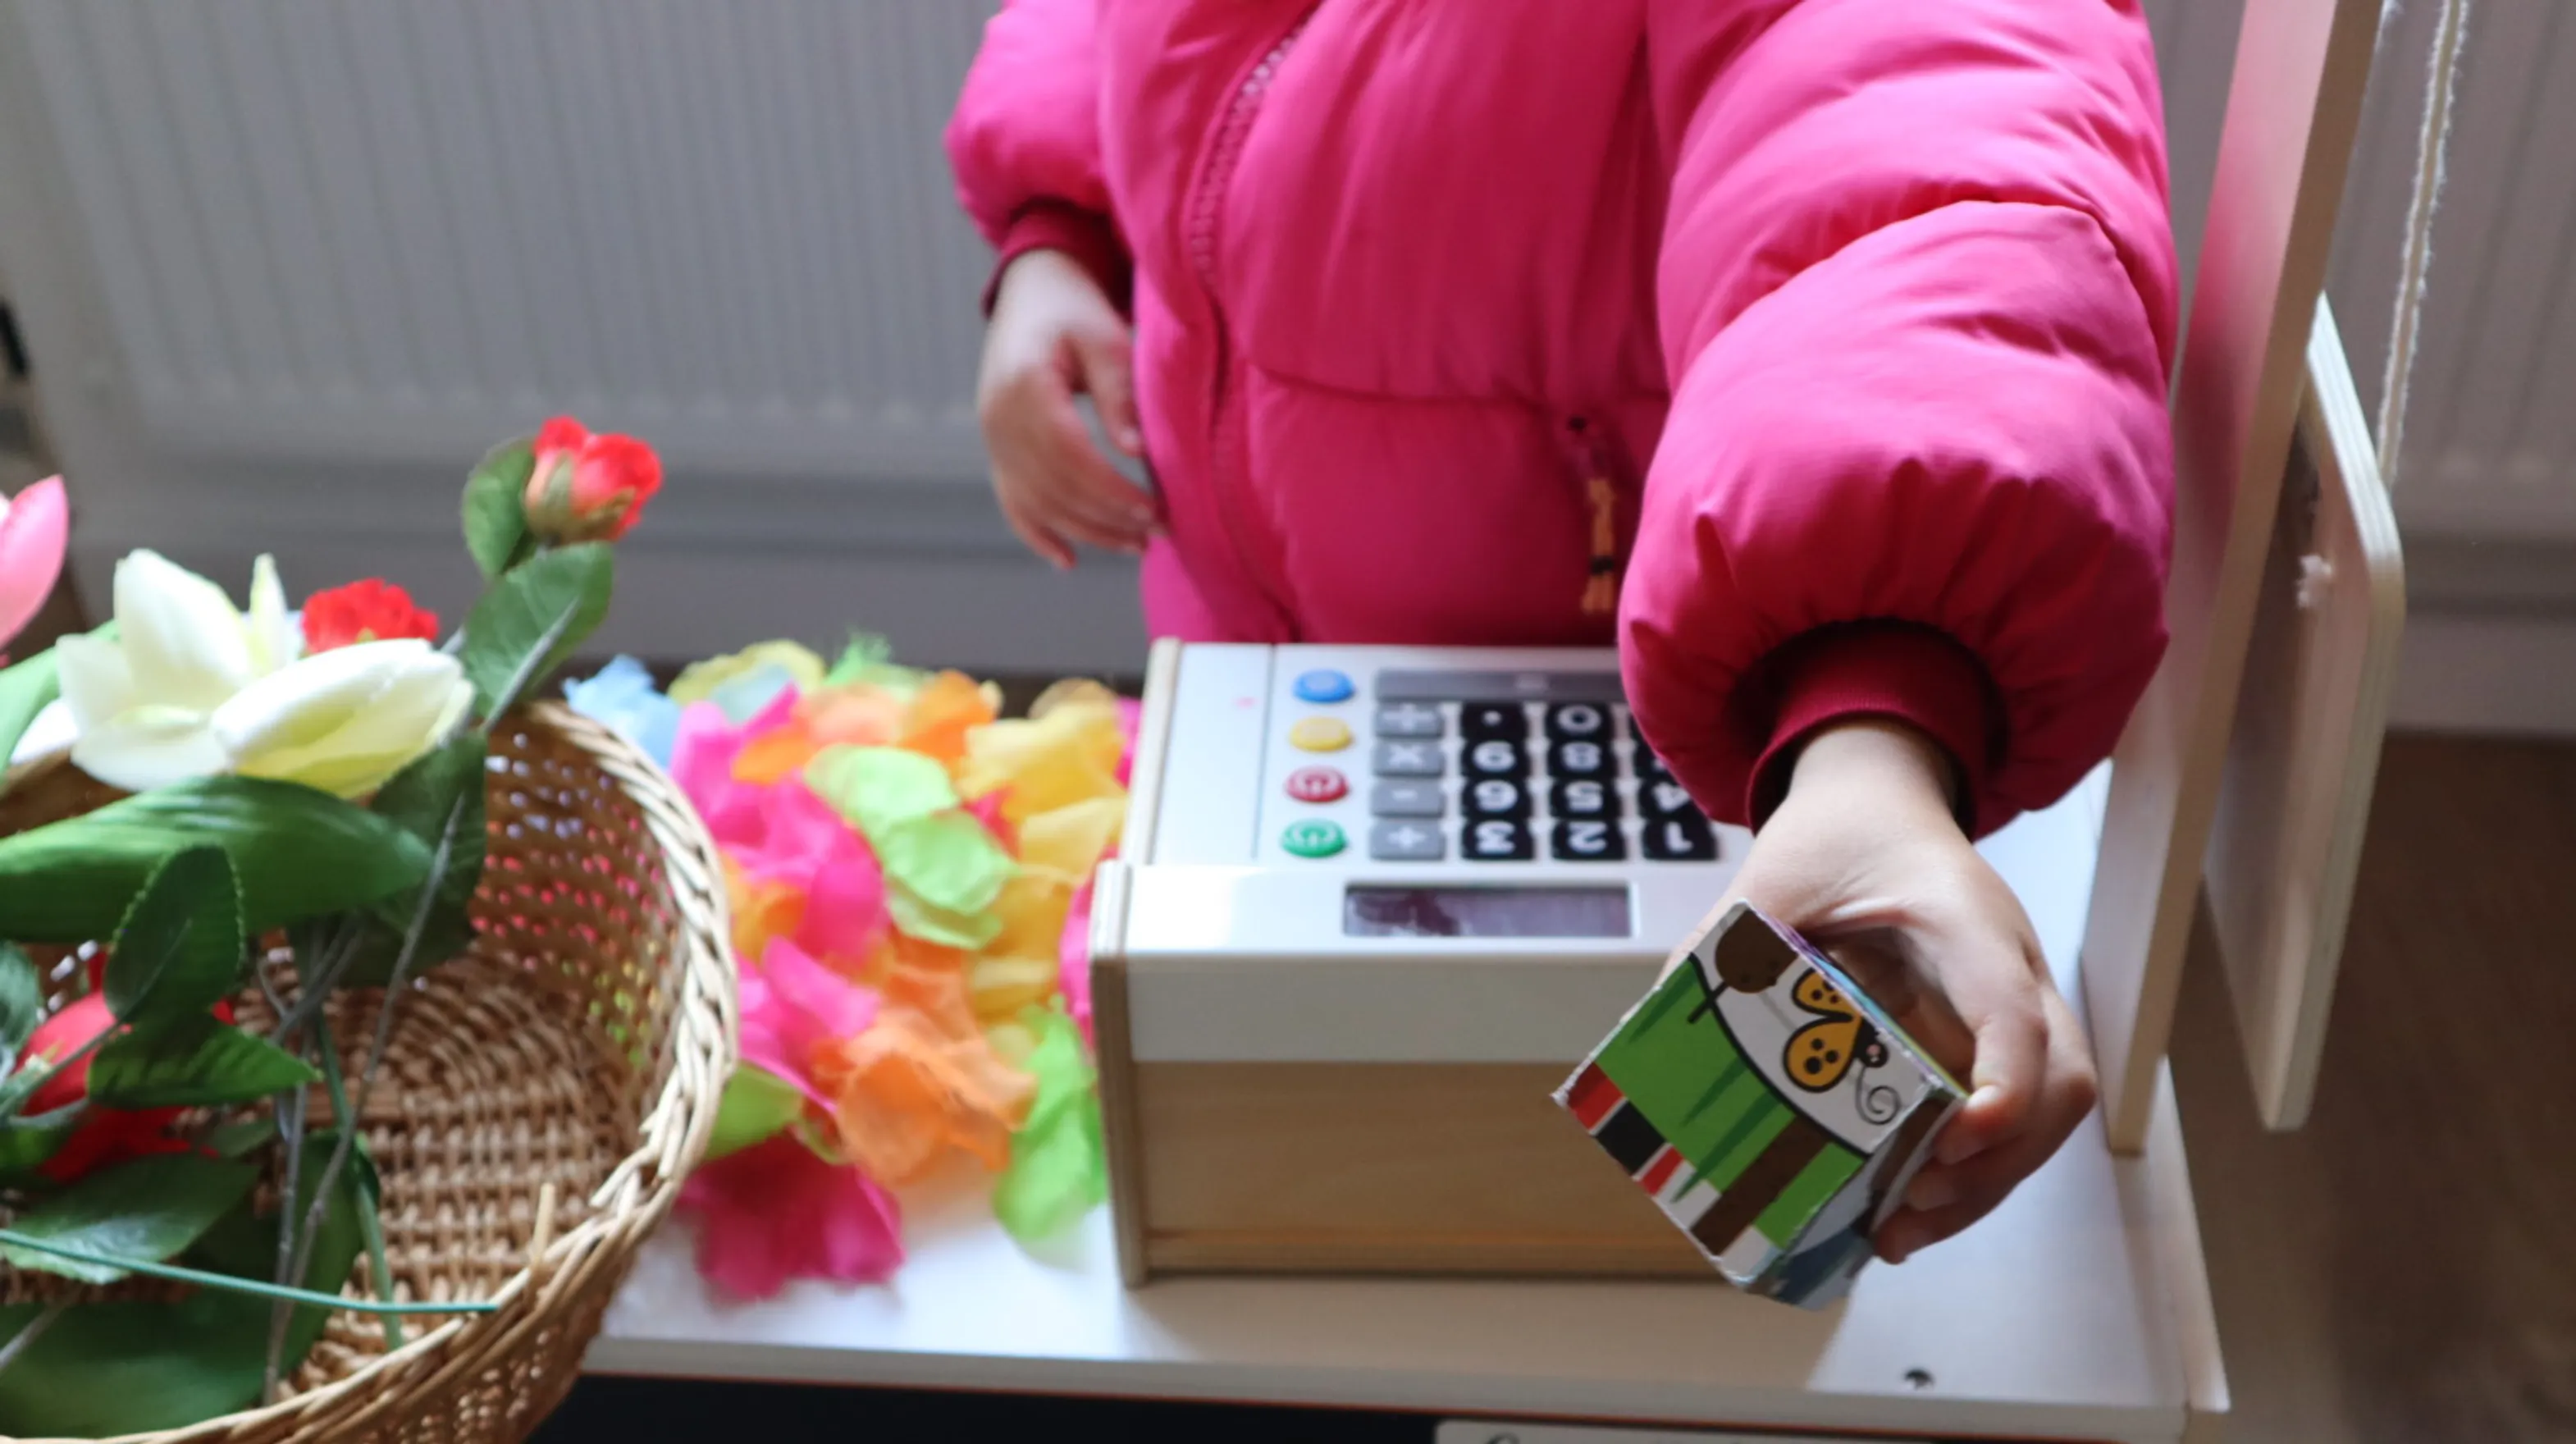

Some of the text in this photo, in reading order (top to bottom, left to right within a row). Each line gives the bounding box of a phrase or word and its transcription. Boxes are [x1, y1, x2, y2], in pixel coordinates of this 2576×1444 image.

[1556, 705, 1601, 734] 0
[1473, 740, 1517, 772] 9
[1562, 741, 1602, 772] 8
[1473, 779, 1518, 812] 6
[1564, 780, 1604, 813] 5
[1652, 781, 1691, 812] 4
[1475, 820, 1516, 854] 3
[1568, 822, 1608, 853] 2
[1664, 821, 1694, 853] 1
